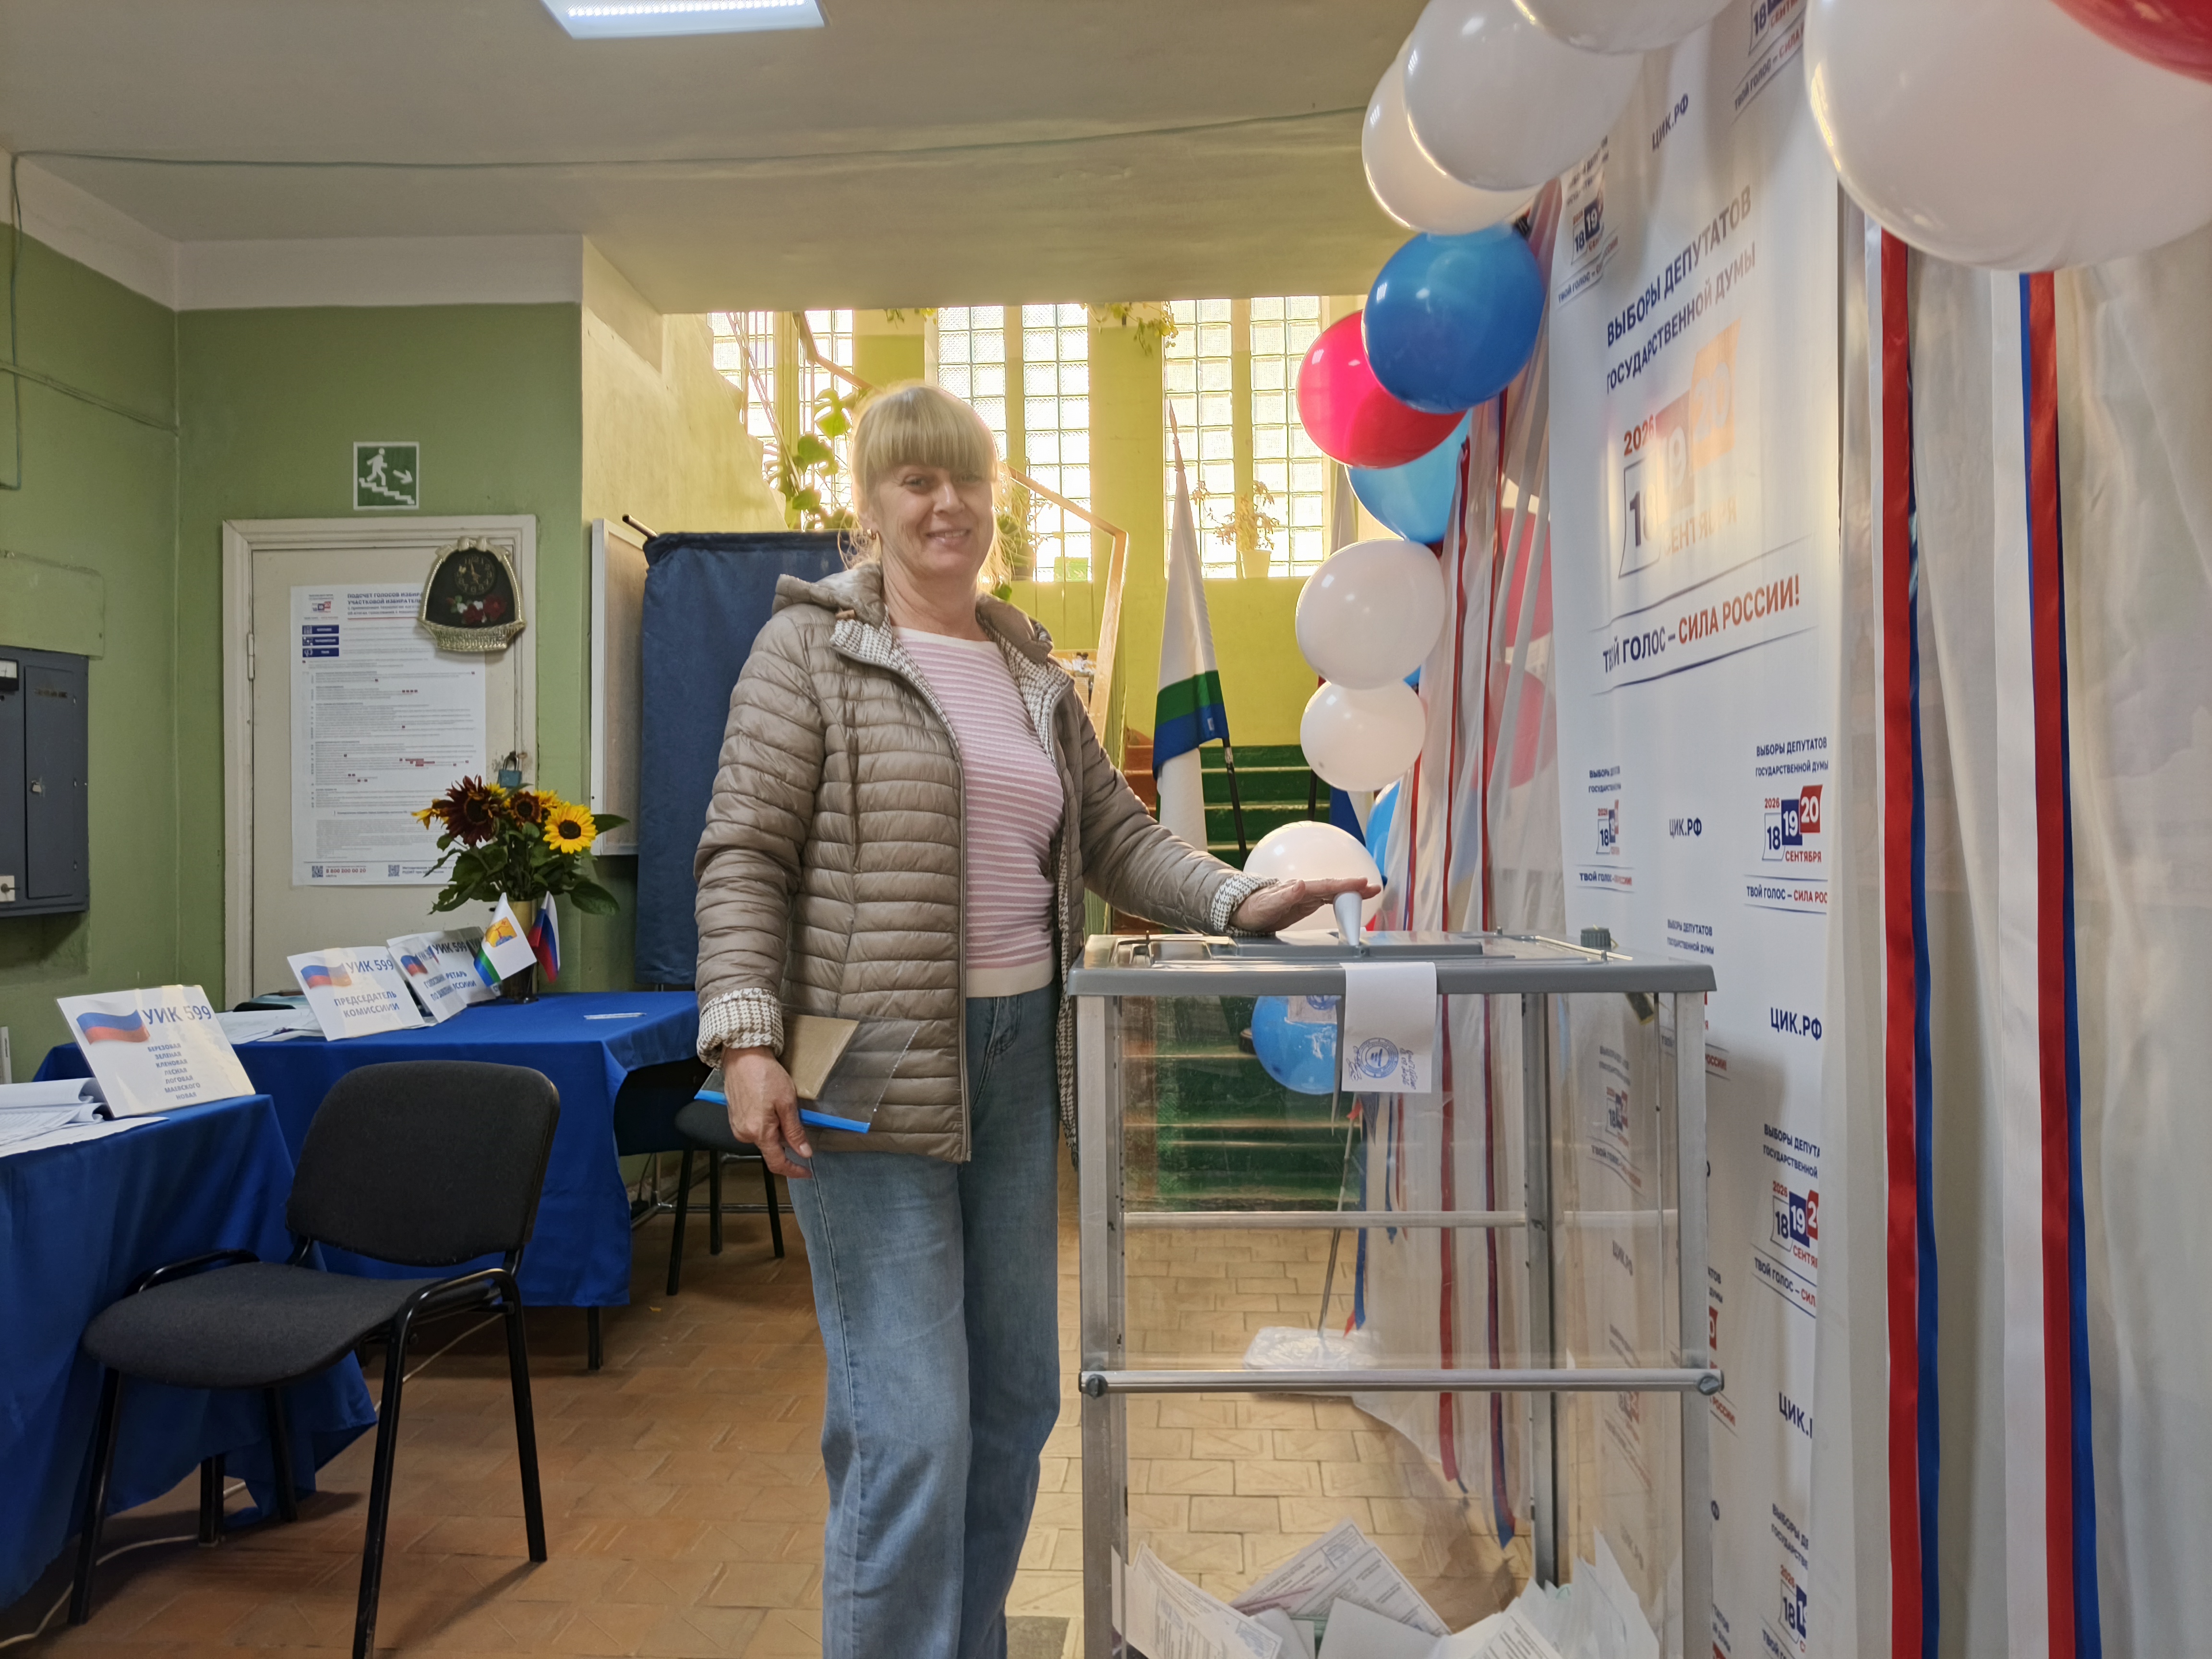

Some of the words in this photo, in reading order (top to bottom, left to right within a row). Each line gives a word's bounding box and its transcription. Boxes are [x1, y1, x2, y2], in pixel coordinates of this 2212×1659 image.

[1754, 2, 1767, 36] 18
[1750, 58, 1771, 91] ГОЛОС
[1652, 94, 1688, 153] ЦИК.РФ
[1586, 212, 1598, 232] 19
[1575, 231, 1585, 252] 18
[1608, 275, 1660, 348] ВЫБОРЫ
[1664, 184, 1751, 300] ДЕПУТАТОВ
[1573, 272, 1590, 293] ГОЛОС
[1607, 276, 1712, 395] ГОСУДАРСТВЕННОЙ
[1715, 241, 1755, 304] ДУМЫ
[1694, 362, 1731, 444] 20
[1624, 414, 1655, 456] 2026
[1623, 626, 1666, 663] ГОЛОС
[1679, 606, 1719, 644] СИЛА
[1722, 574, 1799, 630] РОССИИ!
[1756, 743, 1785, 757] ВЫБОРЫ
[1787, 736, 1827, 755] ДЕПУТАТОВ
[1755, 760, 1811, 777] ГОСУДАРСТВЕННОЙ
[1812, 760, 1828, 773] ДУМЫ
[1765, 798, 1780, 809] 2026
[1801, 795, 1819, 824] 20
[1669, 817, 1702, 839] ЦИК.РФ
[1783, 810, 1798, 837] 19
[1599, 828, 1609, 847] 18
[1767, 826, 1780, 850] 18
[1785, 850, 1822, 863] СЕНТЯБРЯ
[1579, 871, 1597, 882] ТВОЙ
[1746, 884, 1762, 898] ТВОЙ
[1764, 888, 1786, 900] ГОЛОС
[1793, 890, 1813, 902] СИЛА
[1683, 922, 1713, 937] ДЕПУТАТОВ
[432, 942, 454, 955] УИК
[452, 941, 468, 952] 599
[1700, 943, 1714, 955] ДУМЫ
[346, 961, 374, 974] УИК
[374, 959, 394, 971] 599
[334, 991, 397, 1007] ПРЕДСЕДАТЕЛЬ
[142, 1007, 183, 1024] УИК
[183, 1005, 211, 1020] 599
[1771, 1007, 1822, 1041] ЦИК.РФ
[148, 1043, 181, 1052] БЕРЕЗОВАЯ
[155, 1051, 181, 1060] ЗЕЛЕНАЯ
[156, 1059, 188, 1068] КЛЕНОВАЯ
[165, 1068, 187, 1076] ЛЕСНАЯ
[165, 1082, 201, 1093] МАЕВСКОГО
[166, 1075, 193, 1084] ЛОГОВАЯ
[1764, 1123, 1792, 1147] ВЫБОРЫ
[1763, 1144, 1818, 1179] ГОСУДАРСТВЕННОЙ
[1773, 1180, 1788, 1197] 2026
[1791, 1205, 1805, 1235] 19
[1808, 1200, 1818, 1228] 2
[1775, 1211, 1789, 1239] 18
[1755, 1257, 1771, 1278] ТВОЙ
[1772, 1269, 1793, 1293] ГОЛОС
[1801, 1288, 1816, 1308] СИЛ
[1779, 1392, 1813, 1439] ЦИК.
[1783, 1596, 1795, 1630] 18
